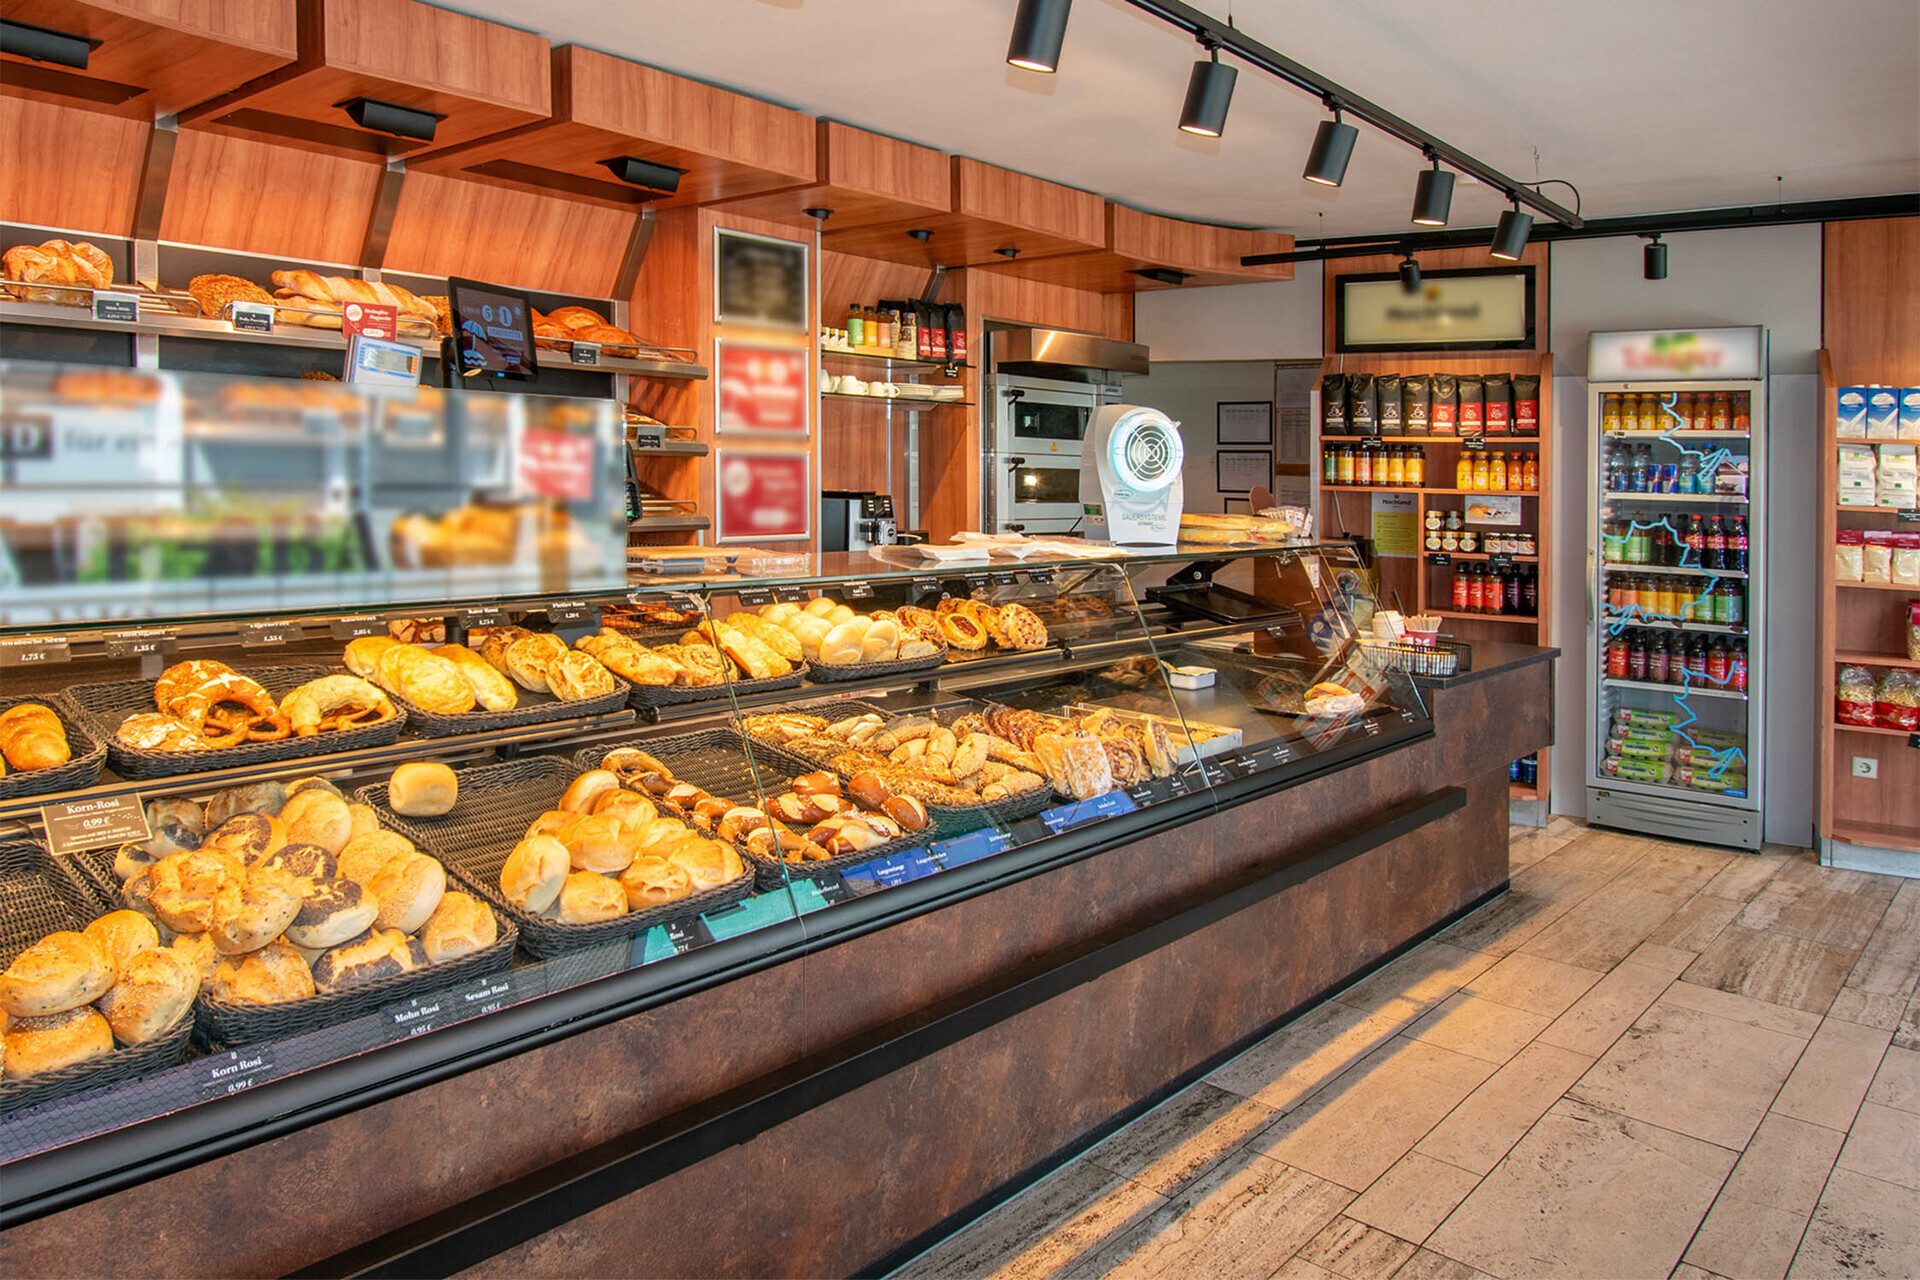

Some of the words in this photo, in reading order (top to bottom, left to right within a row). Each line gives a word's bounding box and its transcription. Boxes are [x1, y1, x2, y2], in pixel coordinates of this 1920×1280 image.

[66, 798, 120, 815] Korn-Rosi
[491, 982, 510, 995] Rosi
[394, 1008, 421, 1024] Mohn
[420, 1002, 441, 1015] Rosi
[211, 1062, 238, 1078] Korn
[239, 1055, 263, 1071] Rosi
